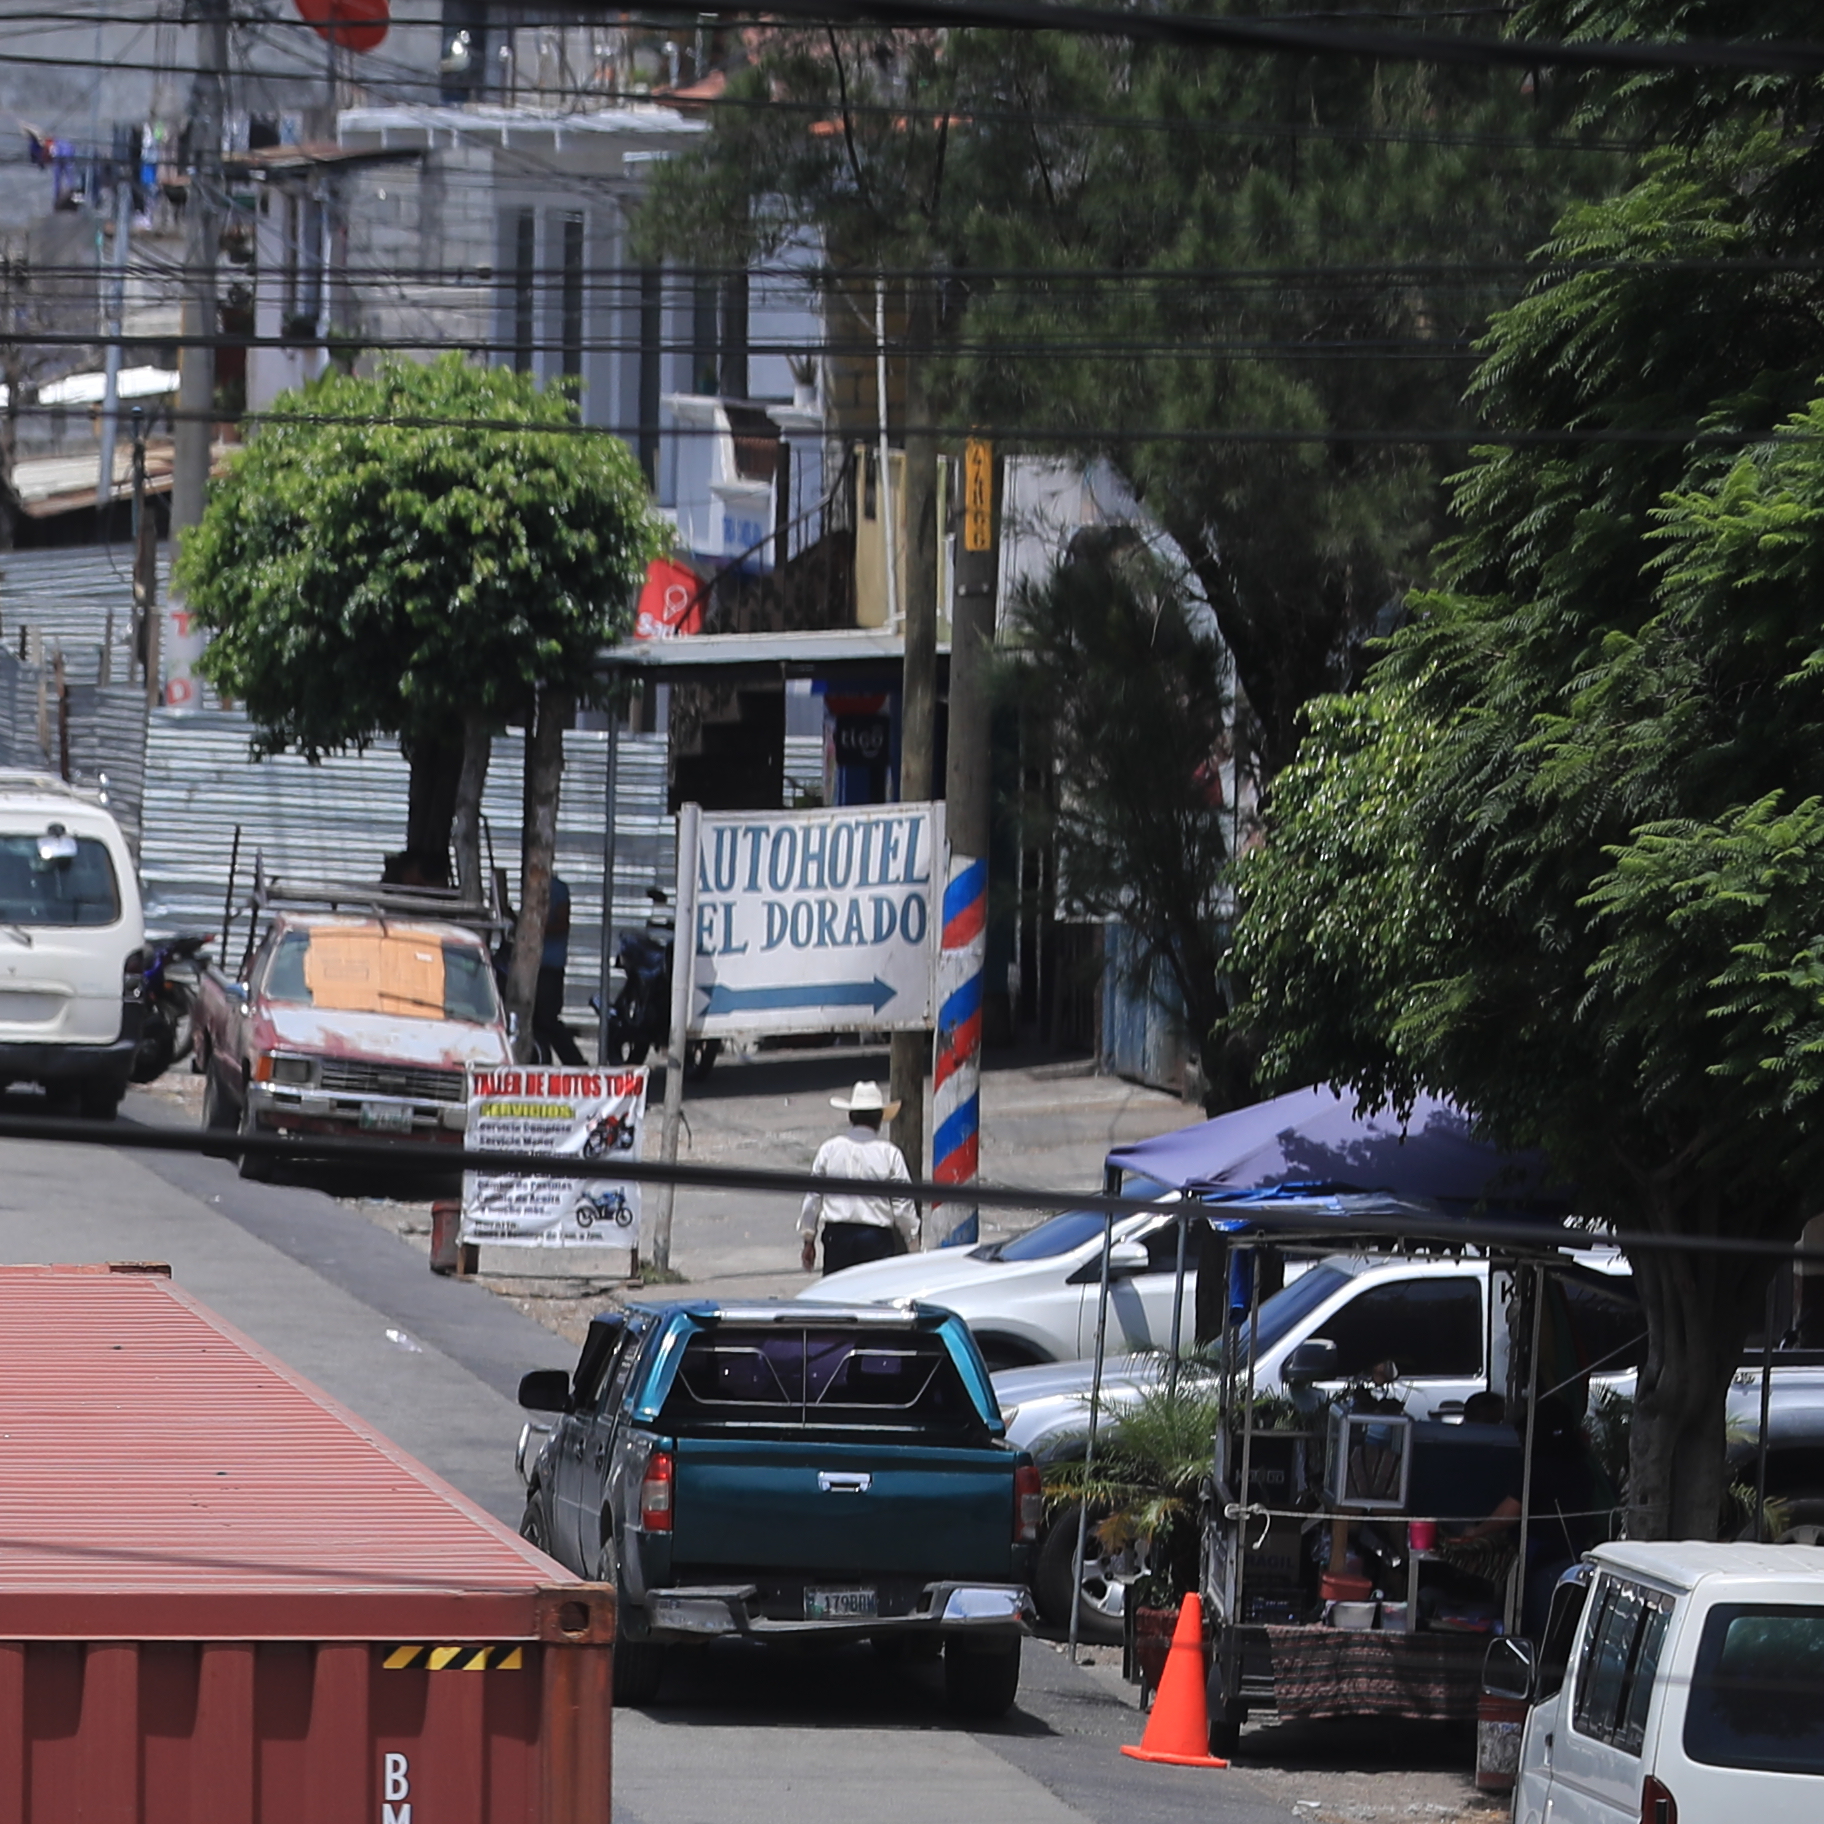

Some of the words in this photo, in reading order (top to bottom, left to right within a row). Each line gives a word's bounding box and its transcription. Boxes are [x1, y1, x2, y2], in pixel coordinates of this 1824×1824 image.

[696, 900, 749, 957] EL
[759, 892, 928, 953] DORADO
[473, 1073, 522, 1096] TALLER
[526, 1074, 545, 1096] DE
[548, 1074, 602, 1097] MOTOS
